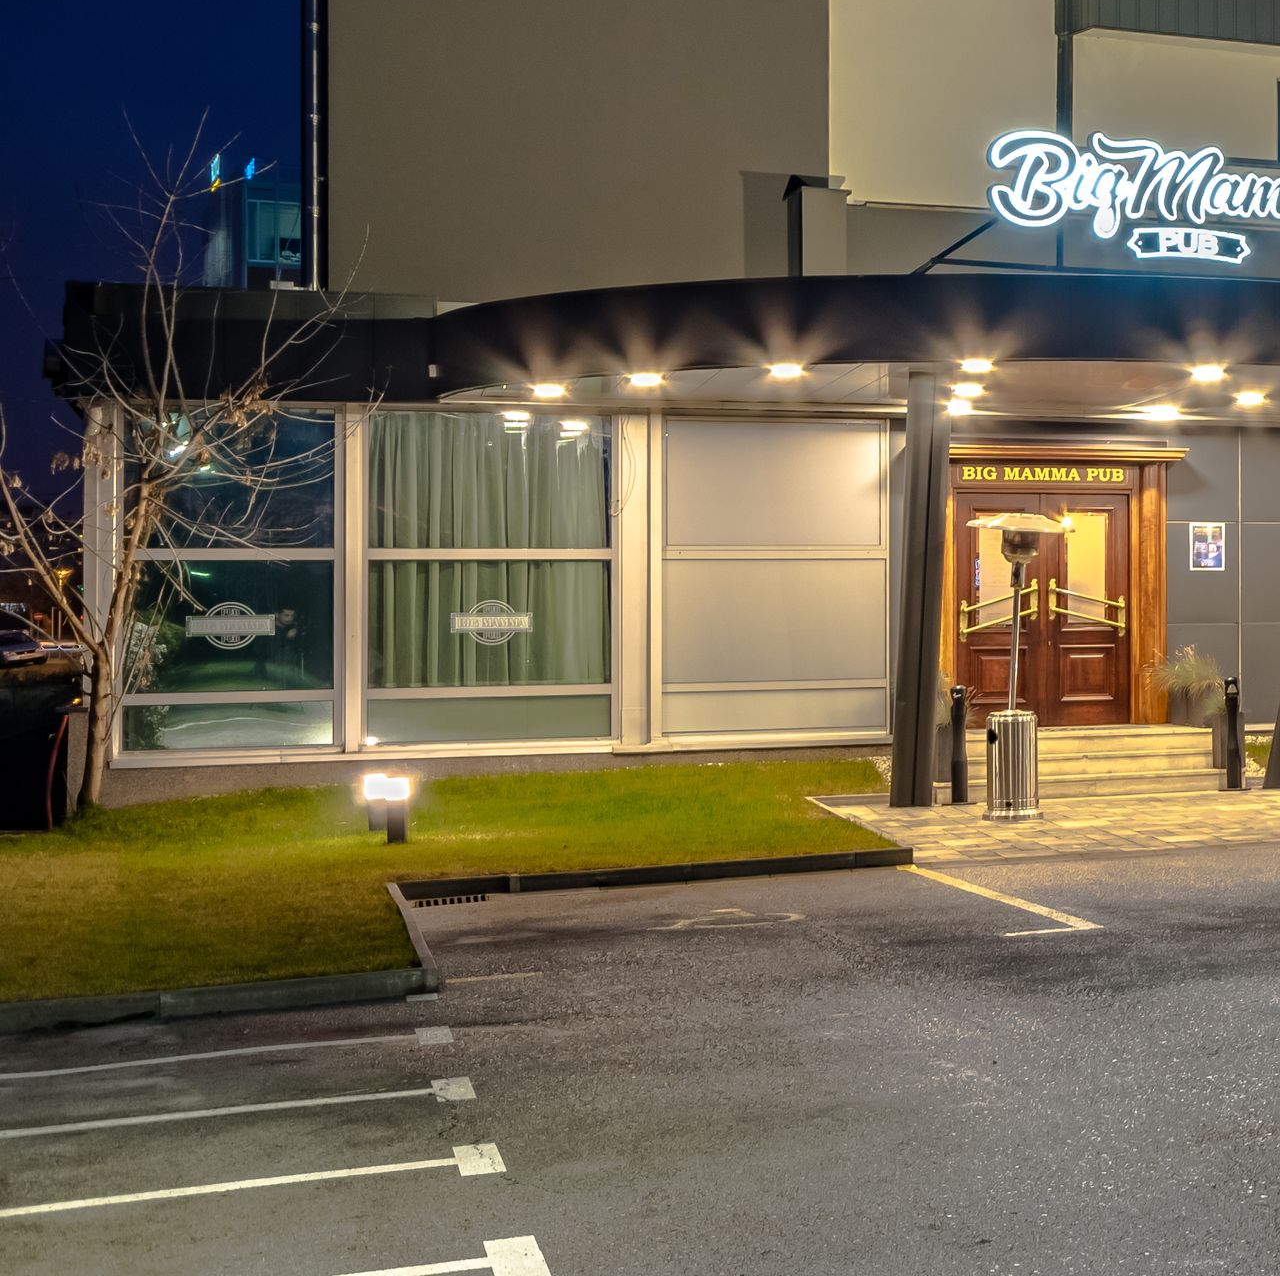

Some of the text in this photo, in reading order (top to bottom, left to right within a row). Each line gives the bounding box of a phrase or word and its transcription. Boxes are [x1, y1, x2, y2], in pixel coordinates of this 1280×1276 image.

[986, 129, 1128, 238] Big
[1158, 231, 1220, 255] PUB
[962, 466, 1125, 483] BIG MAMMA PUB
